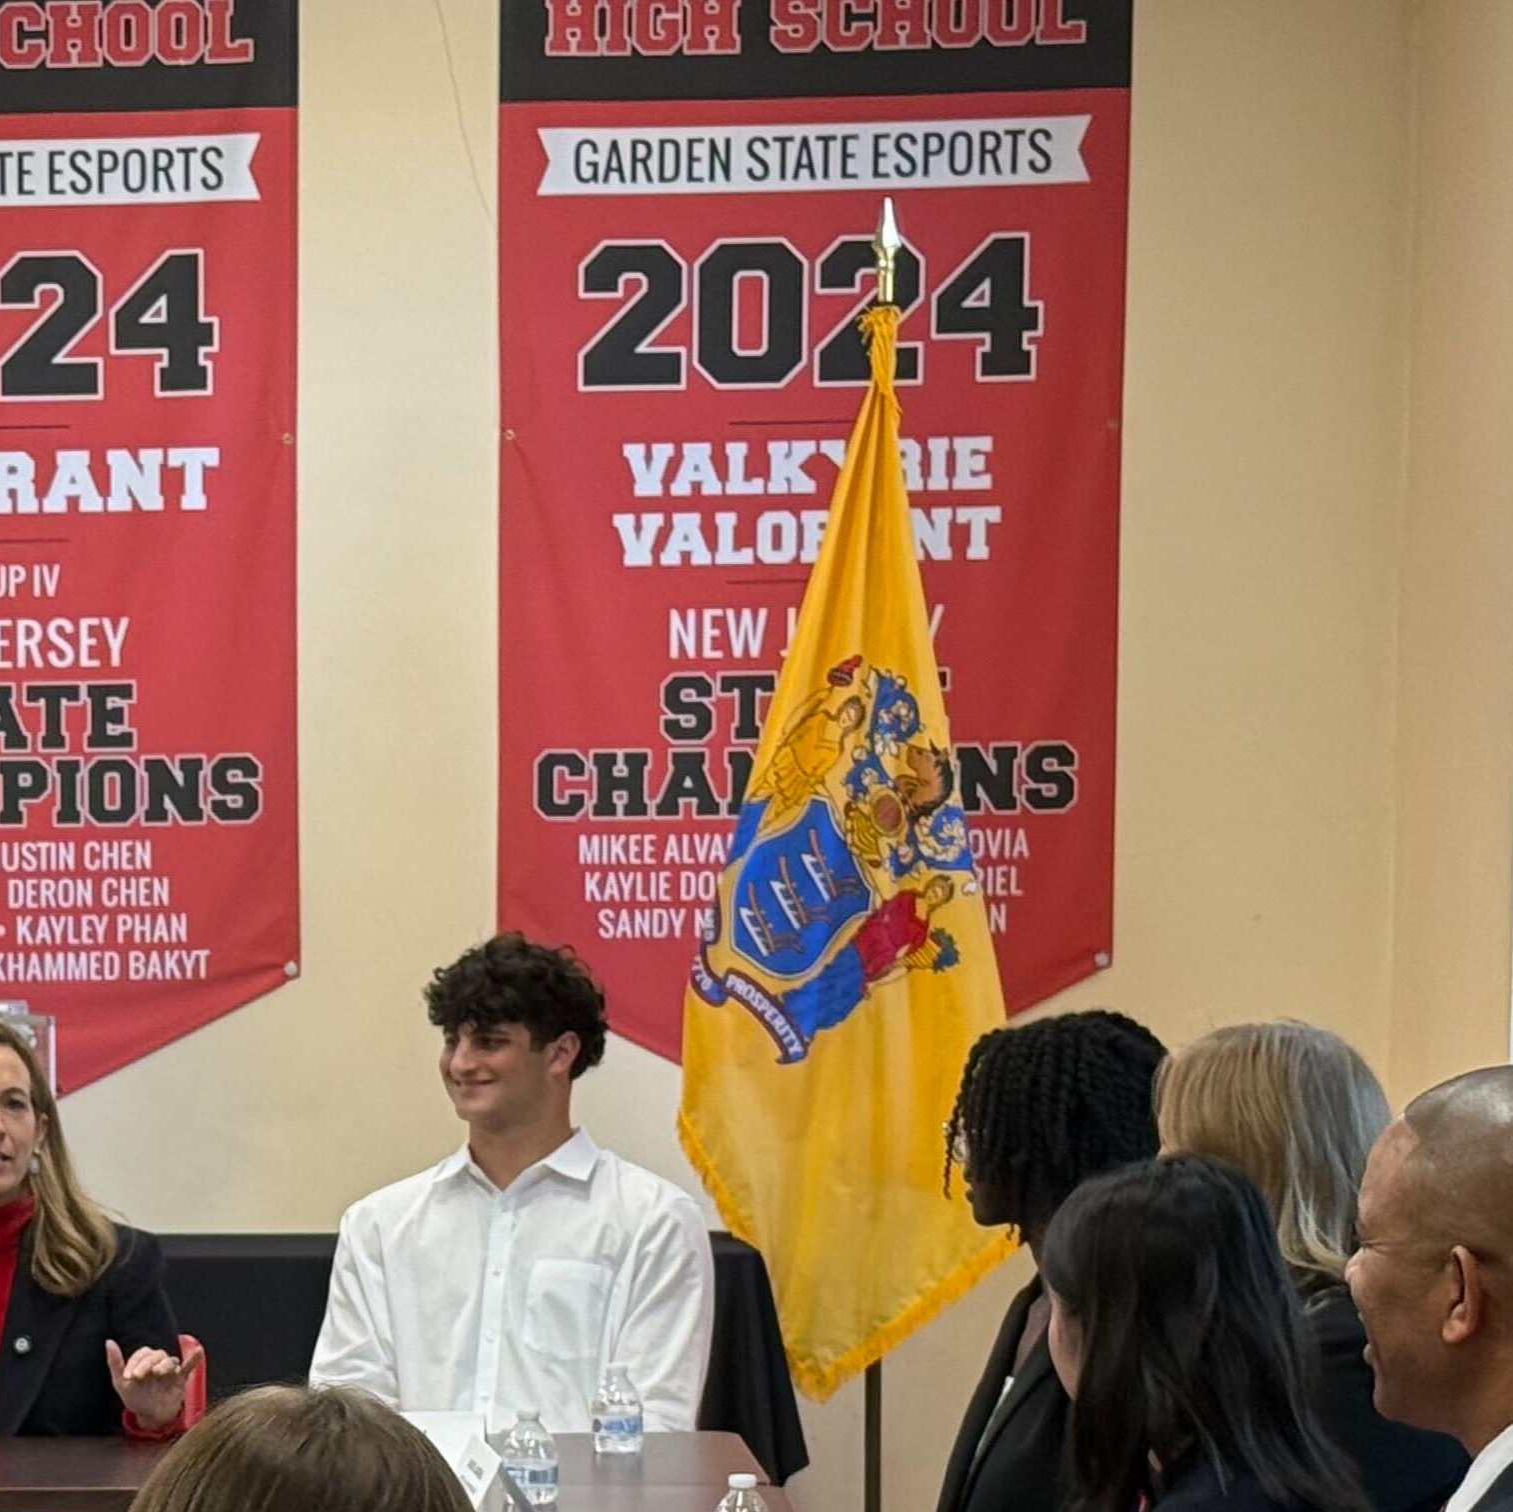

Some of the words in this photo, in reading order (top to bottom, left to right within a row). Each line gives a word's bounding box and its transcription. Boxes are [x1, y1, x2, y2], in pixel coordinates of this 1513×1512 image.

[545, 0, 741, 56] HIGH
[769, 0, 1086, 52] SCHOOL
[47, 146, 224, 195] ESPORTS
[574, 138, 732, 185] GARDEN
[746, 134, 858, 182] STATE
[872, 128, 1053, 178] ESPORTS
[578, 232, 1044, 391] 2024
[613, 505, 1001, 567] VALONT
[33, 564, 60, 597] IV
[669, 607, 768, 660] NEW
[533, 740, 1079, 821] CHANS
[84, 840, 152, 870] CHEN
[578, 834, 657, 865] MIKEE
[663, 832, 735, 864] ALVA
[968, 828, 1030, 859] OVIA
[7, 878, 94, 908] DERON
[101, 877, 169, 907] CHEN
[585, 871, 672, 902] KAYLIE
[16, 914, 109, 945] KAYLEY
[116, 913, 187, 943] PHAN
[598, 908, 685, 940] SANDY
[128, 950, 210, 980] BAKYT
[725, 973, 804, 1052] PROSPERITY
